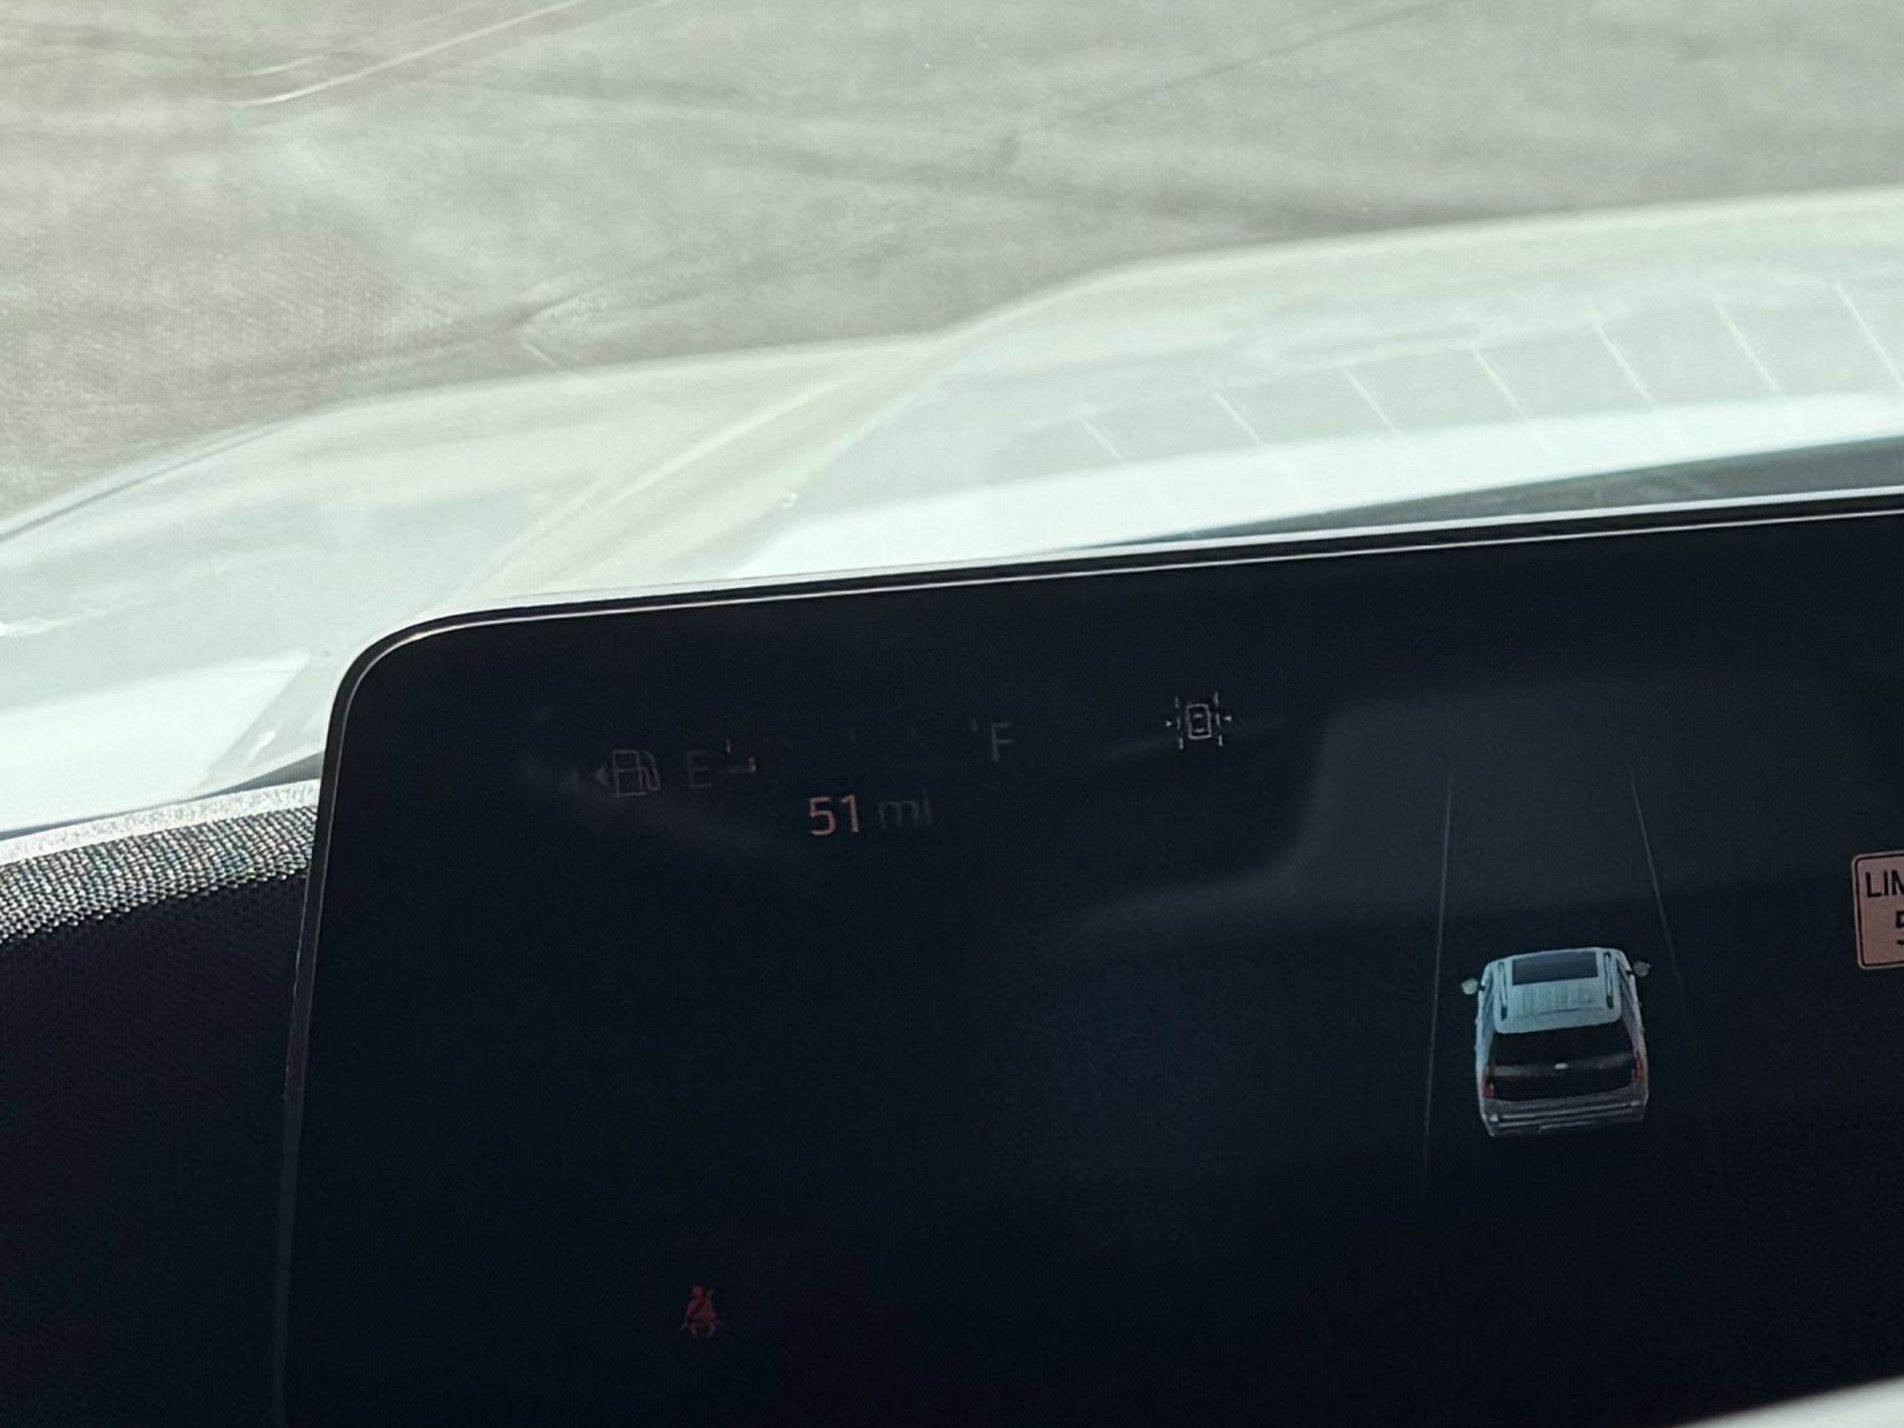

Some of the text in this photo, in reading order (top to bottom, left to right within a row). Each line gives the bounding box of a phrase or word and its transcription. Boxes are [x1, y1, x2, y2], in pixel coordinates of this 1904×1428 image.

[990, 722, 1015, 763] F
[686, 750, 712, 789] E
[808, 788, 933, 837] 51 mi
